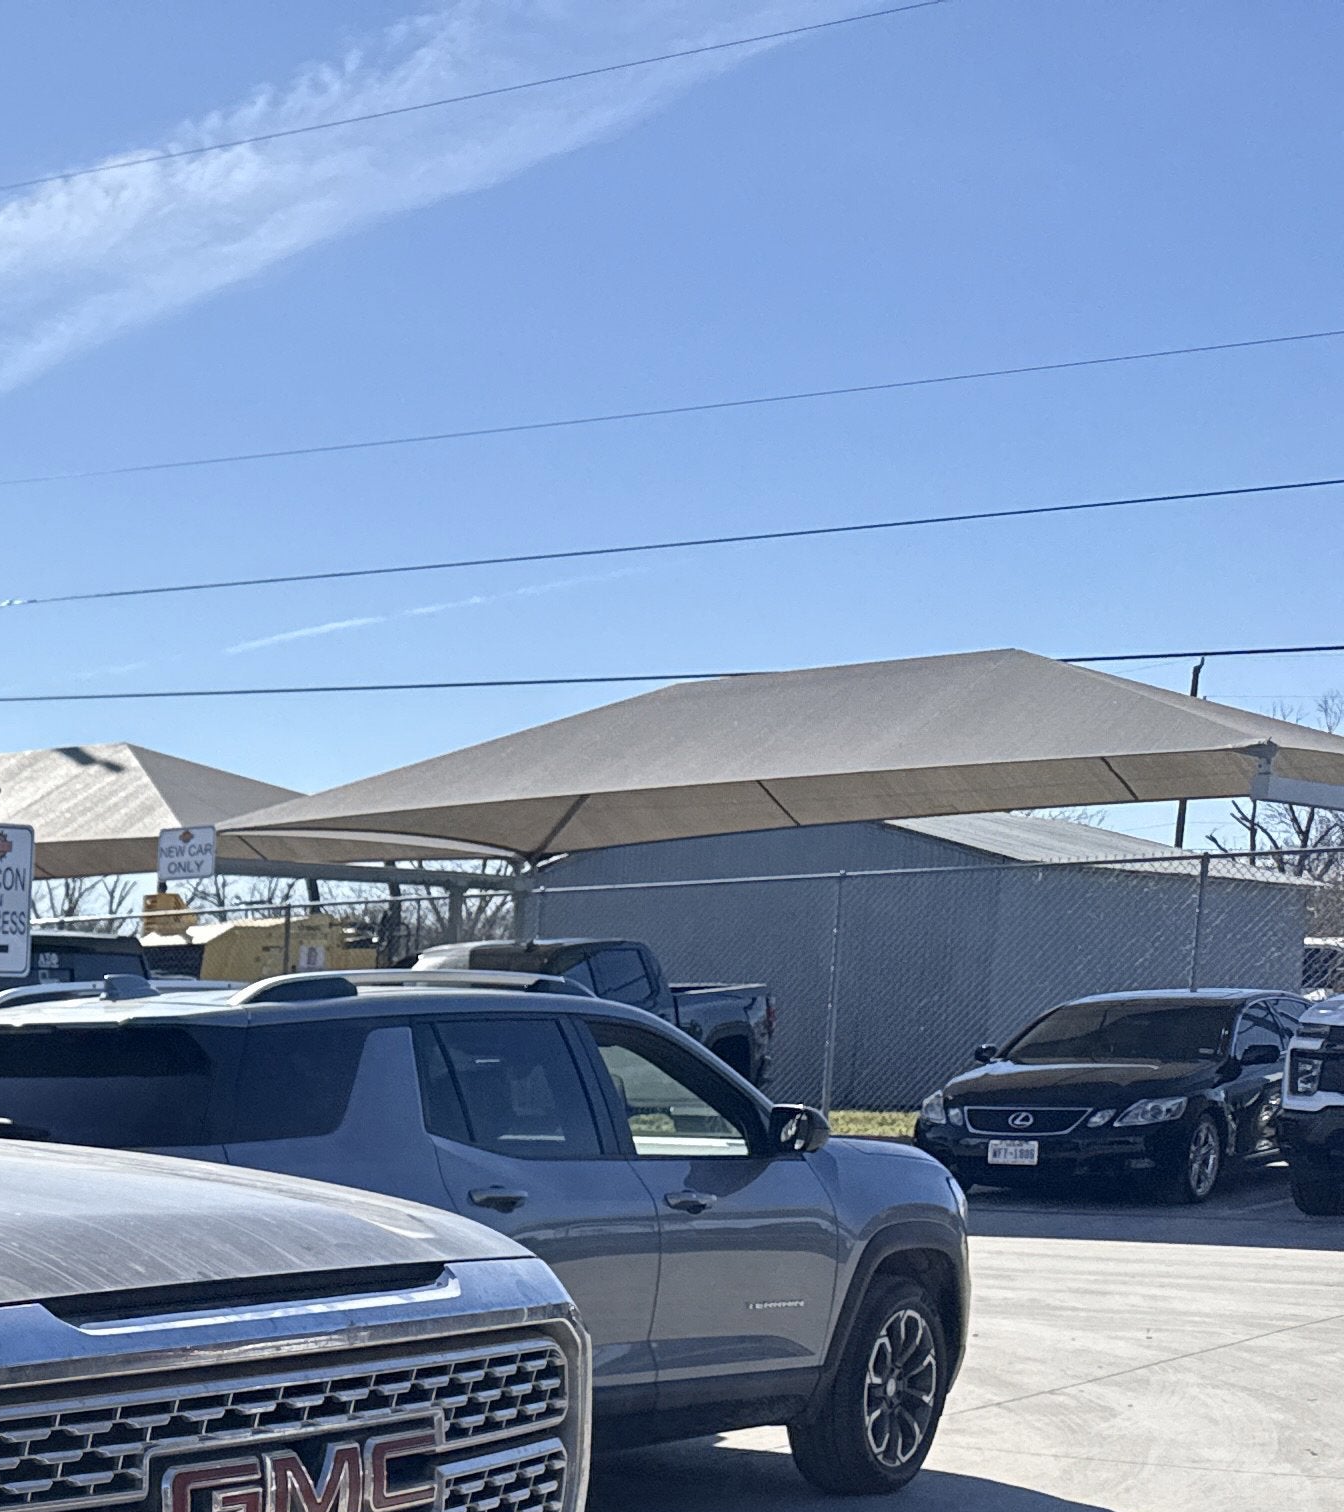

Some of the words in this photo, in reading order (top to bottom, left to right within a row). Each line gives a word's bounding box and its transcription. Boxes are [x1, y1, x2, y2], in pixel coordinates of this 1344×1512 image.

[160, 845, 186, 859] NEW
[188, 843, 213, 857] CAR
[167, 859, 205, 874] ONLY
